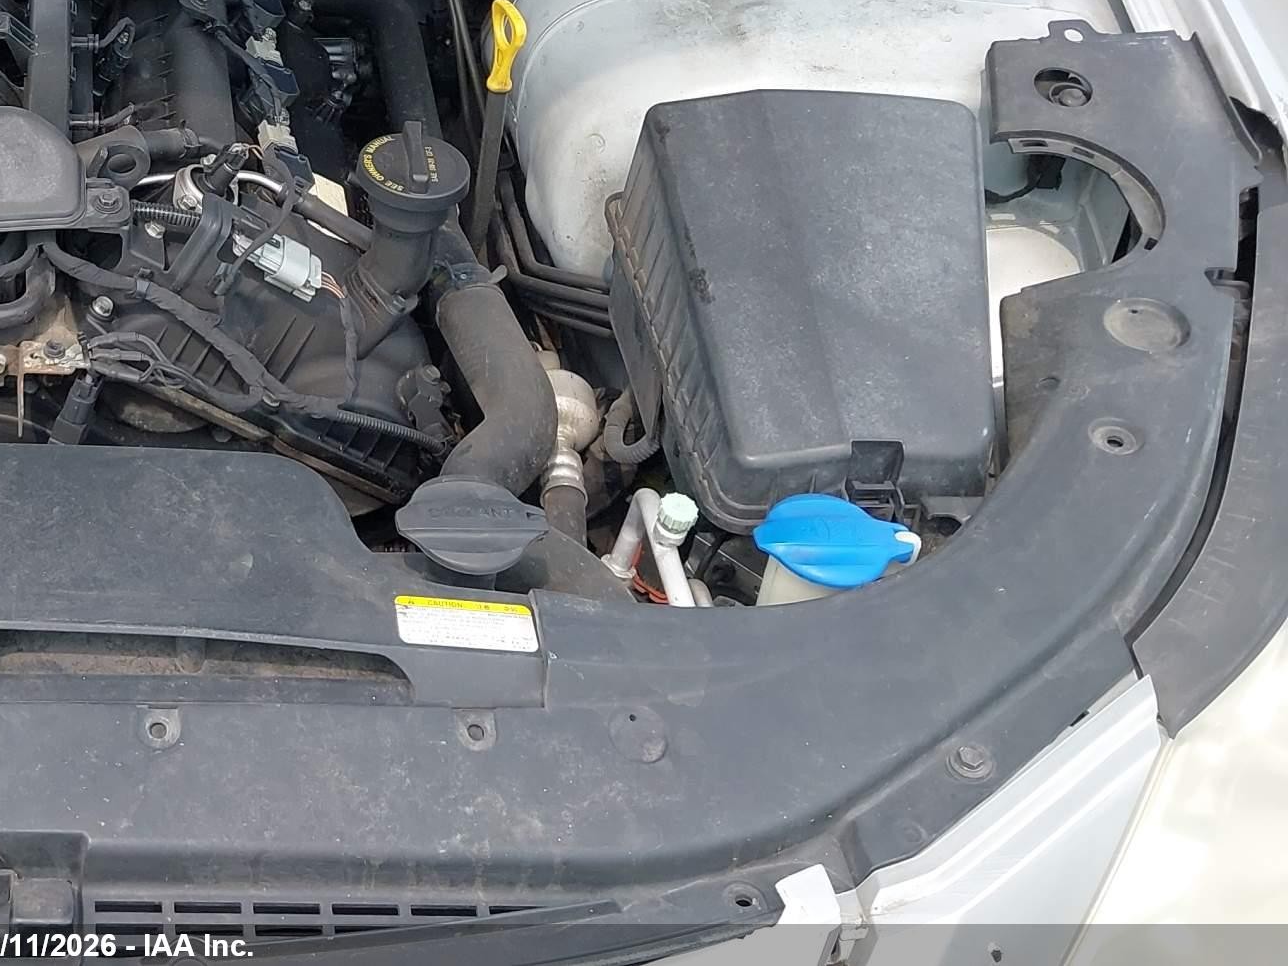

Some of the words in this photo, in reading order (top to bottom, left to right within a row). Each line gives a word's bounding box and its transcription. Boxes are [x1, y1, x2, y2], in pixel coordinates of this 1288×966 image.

[365, 134, 396, 154] MANUAL
[384, 179, 405, 192] SEE
[427, 599, 463, 608] CAUTION
